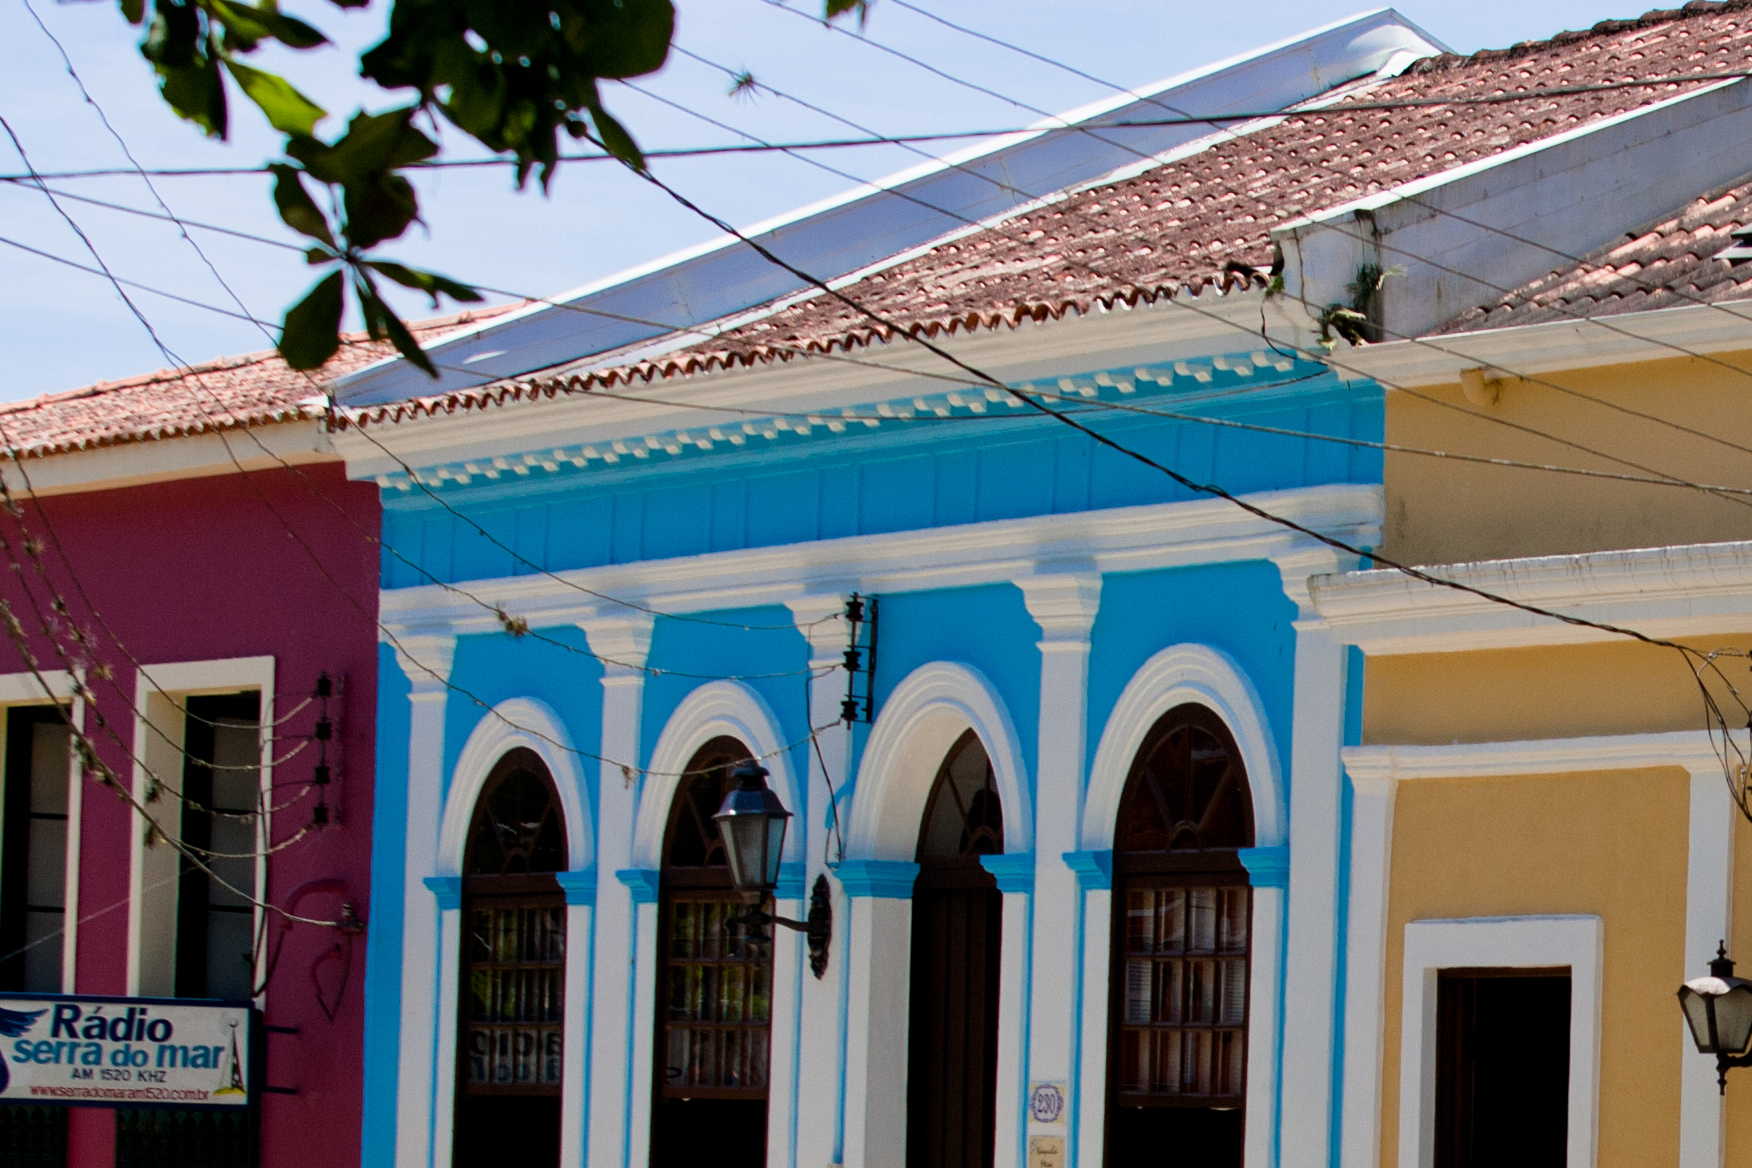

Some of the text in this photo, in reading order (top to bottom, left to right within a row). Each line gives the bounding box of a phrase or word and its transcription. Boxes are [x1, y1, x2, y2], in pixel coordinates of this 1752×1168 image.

[51, 1003, 174, 1043] Rádio
[12, 1038, 225, 1070] serra do mar
[71, 1068, 168, 1084] AM 1520 KHZ
[1037, 1093, 1057, 1114] 230
